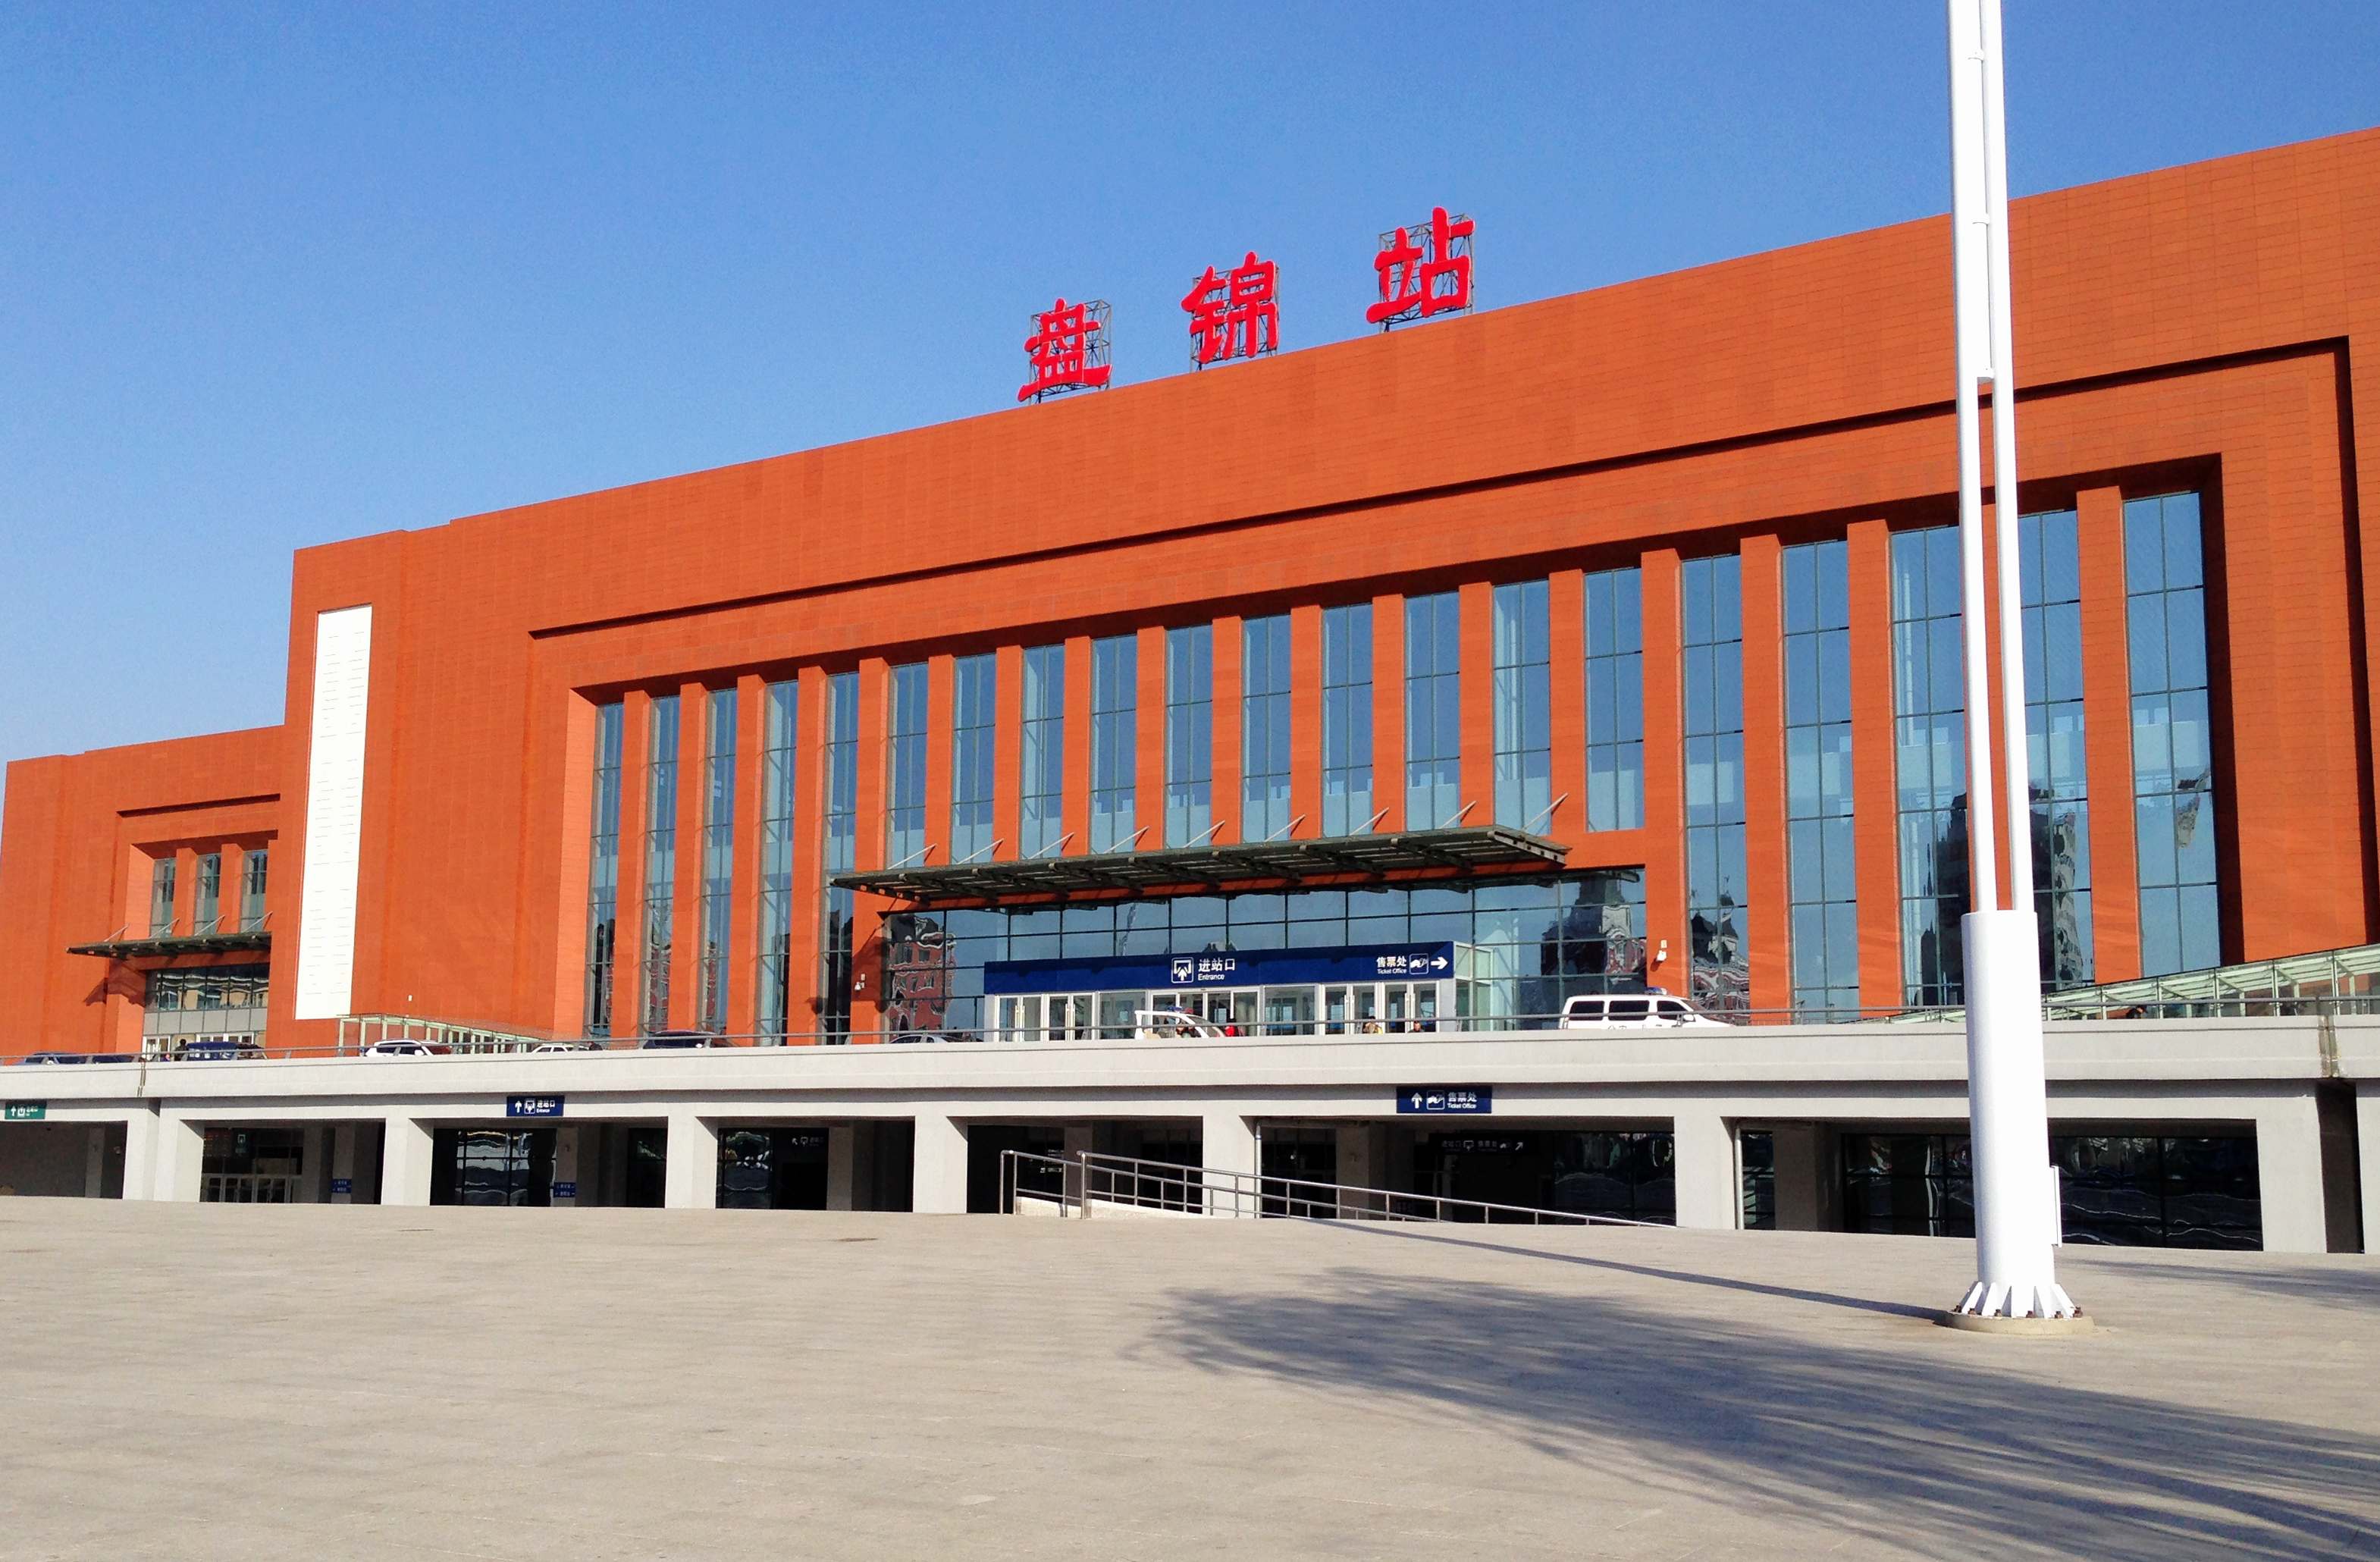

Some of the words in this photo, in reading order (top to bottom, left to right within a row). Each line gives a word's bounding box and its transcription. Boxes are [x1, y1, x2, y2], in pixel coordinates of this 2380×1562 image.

[1018, 206, 1475, 403] 盘锦站
[1198, 958, 1236, 972] 进站口
[1376, 955, 1407, 968] 售票处
[1198, 973, 1225, 981] Entrance
[1447, 1091, 1477, 1102] 售票处
